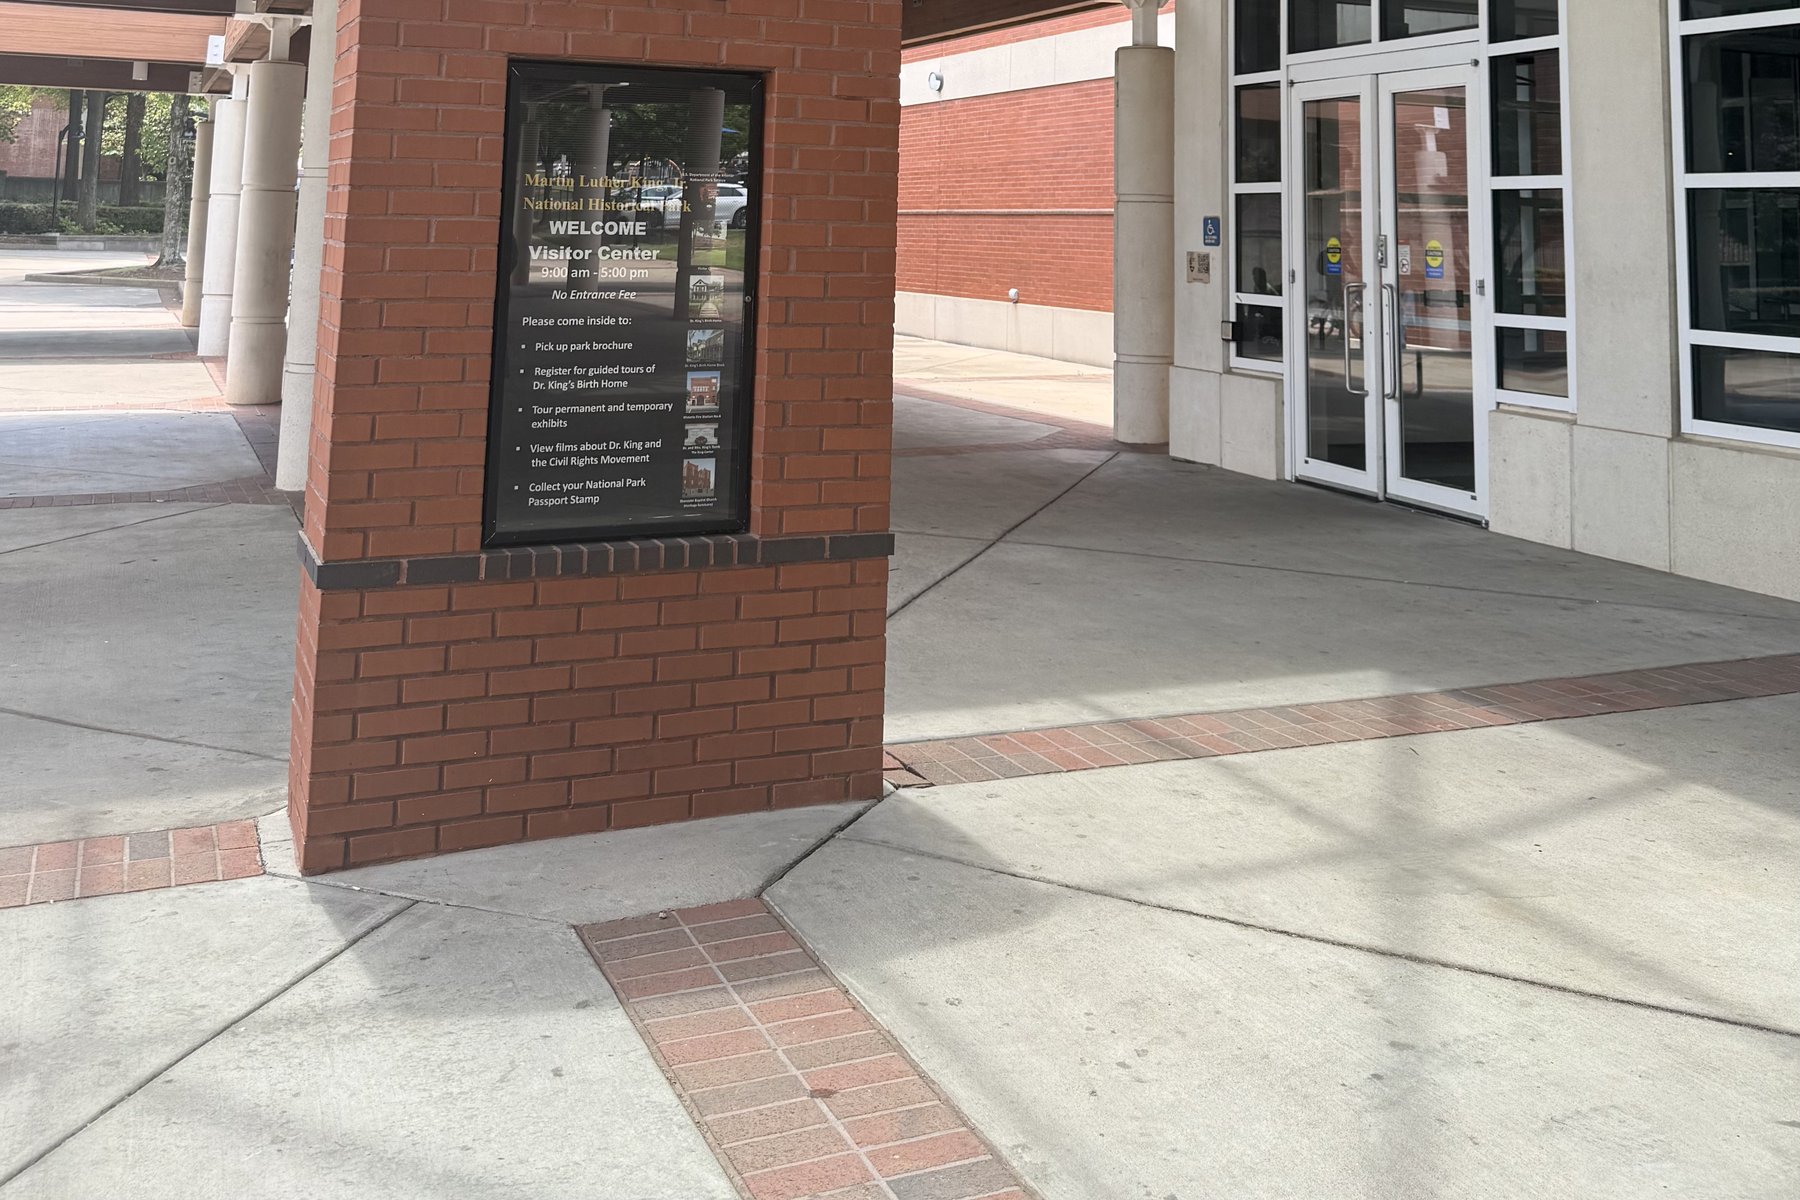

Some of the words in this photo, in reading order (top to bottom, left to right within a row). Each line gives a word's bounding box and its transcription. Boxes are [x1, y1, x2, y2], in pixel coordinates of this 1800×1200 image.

[524, 173, 575, 187] Martin
[579, 175, 625, 189] Luther
[630, 176, 668, 193] King,
[674, 177, 689, 190] Jr.
[523, 196, 584, 211] National
[588, 198, 656, 212] Historical
[548, 220, 647, 236] WELCOME
[528, 245, 592, 260] Visitor
[597, 246, 661, 261] Center
[541, 267, 568, 278] 9:00
[571, 269, 590, 278] am
[601, 267, 627, 278] 5:00
[630, 269, 649, 281] pm
[552, 290, 567, 300] No
[570, 290, 617, 300] Entrance
[619, 290, 637, 300] Fee
[522, 316, 555, 327] Please
[557, 318, 584, 326] come
[587, 316, 616, 326] inside
[618, 316, 632, 326] to:
[535, 342, 554, 351] Pick
[556, 344, 568, 353] up
[570, 341, 590, 353] park
[592, 341, 633, 350] brochure
[534, 366, 571, 377] Register
[573, 365, 586, 375] for
[588, 365, 619, 377] guided
[621, 365, 644, 374] tours
[645, 364, 656, 373] of
[533, 380, 546, 390] Dr.
[548, 379, 575, 391] King’s
[577, 379, 599, 389] Birth
[601, 379, 628, 388] Home
[532, 405, 553, 414] Tour
[555, 404, 605, 415] permanent
[607, 402, 625, 412] and
[626, 402, 673, 413] temporary
[531, 418, 567, 428] exhibits
[530, 443, 553, 453] View
[555, 441, 578, 452] films
[580, 441, 606, 451] about
[608, 441, 621, 450] Dr.
[623, 440, 643, 451] King
[644, 439, 662, 449] and
[531, 457, 547, 467] the
[549, 456, 569, 466] Civil
[570, 455, 598, 467] Rights
[600, 454, 650, 465] Movement
[529, 482, 561, 492] Collect
[562, 482, 584, 492] your
[586, 479, 624, 489] National
[626, 478, 646, 487] Park
[528, 496, 568, 507] Passport
[570, 495, 600, 506] Stamp
